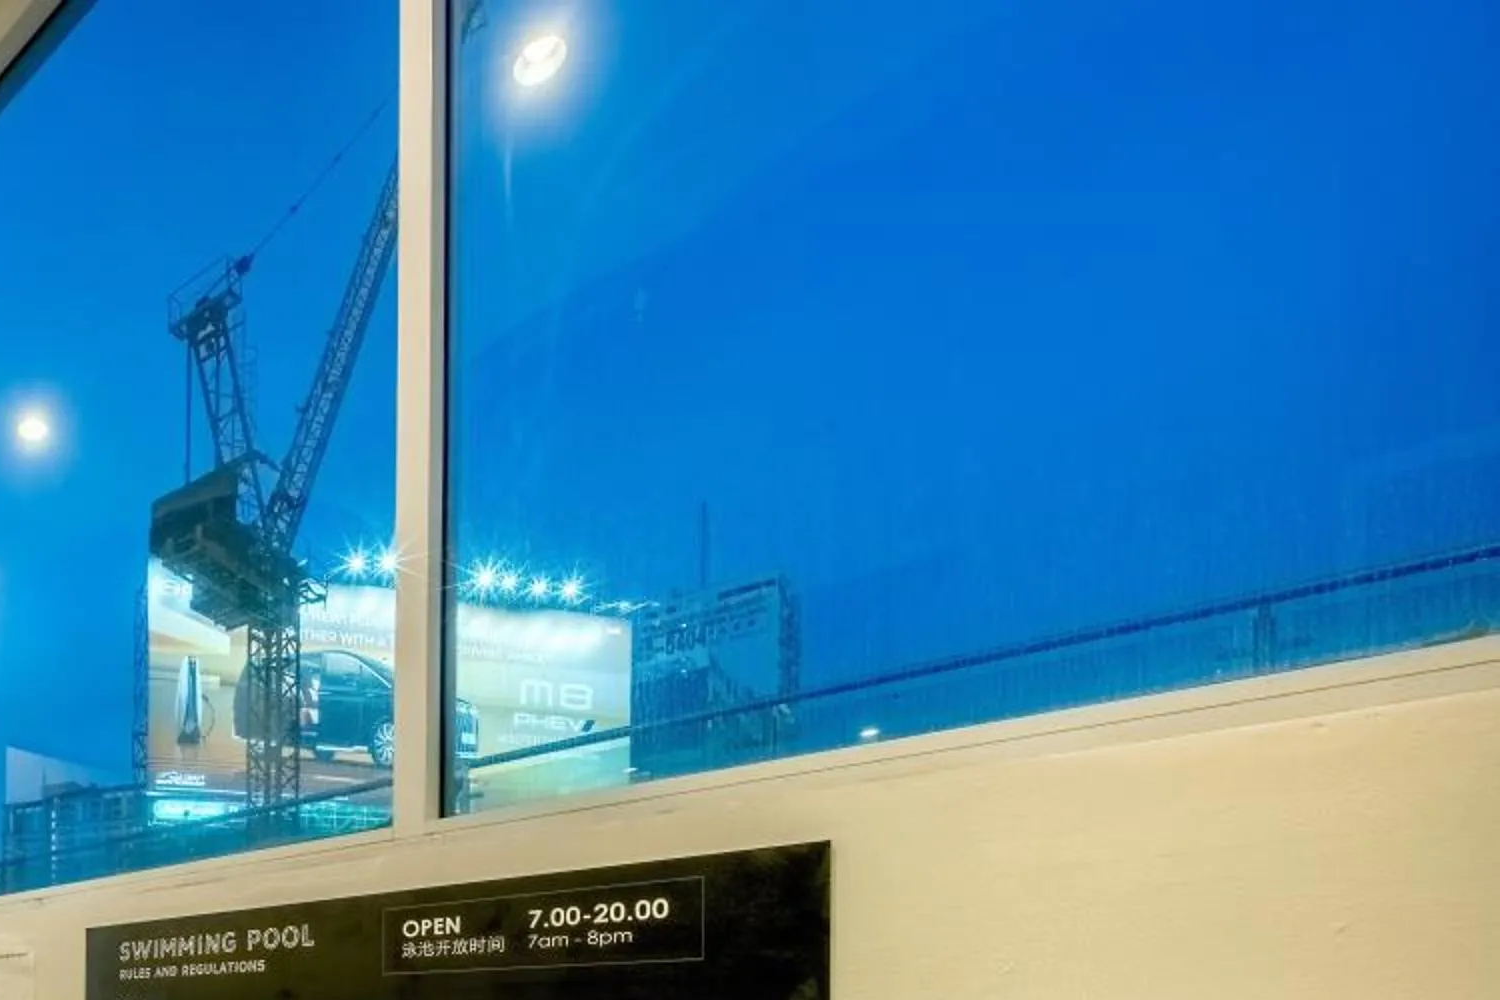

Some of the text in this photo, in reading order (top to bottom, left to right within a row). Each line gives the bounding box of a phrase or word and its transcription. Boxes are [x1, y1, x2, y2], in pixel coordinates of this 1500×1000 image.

[402, 898, 670, 938] OPEN 7.00-20.00
[119, 924, 315, 962] SWIMMING POOL
[401, 936, 505, 959] 泳池开放时间
[527, 933, 569, 949] 7am
[587, 929, 634, 948] 8pm
[119, 960, 266, 981] RULES AND REGULATIONS
